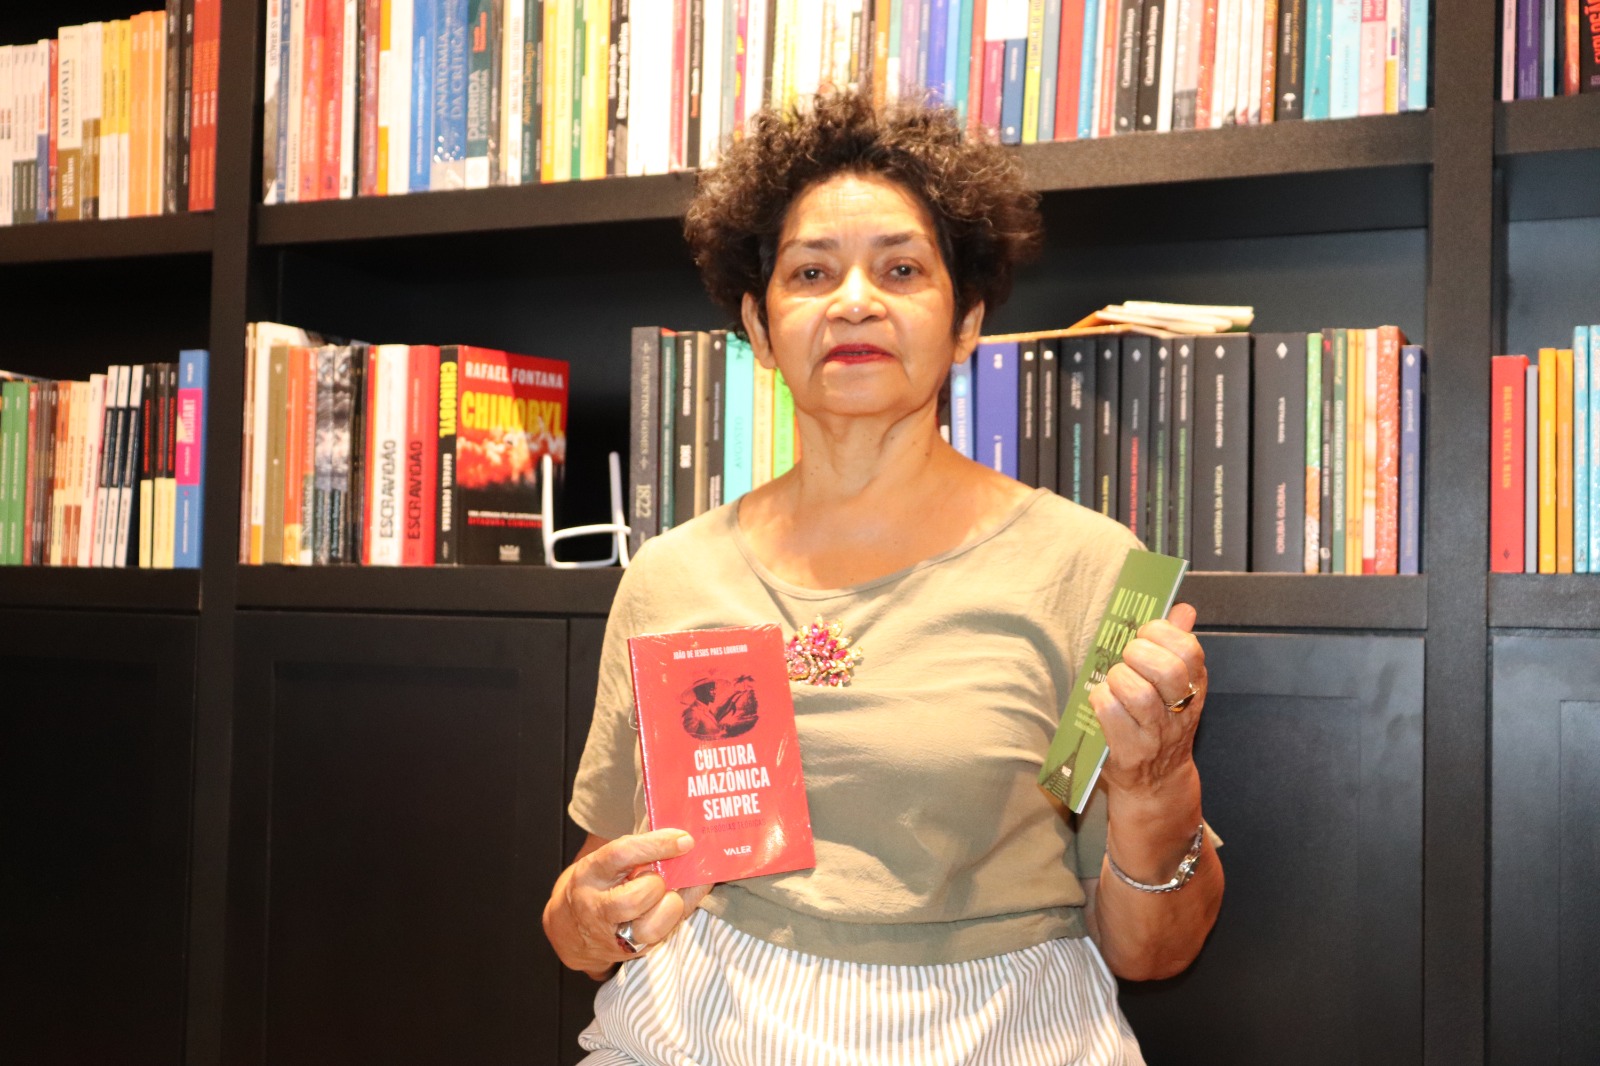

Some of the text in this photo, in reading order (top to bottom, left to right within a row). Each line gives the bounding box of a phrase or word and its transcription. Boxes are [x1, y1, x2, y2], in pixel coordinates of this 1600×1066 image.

[467, 70, 480, 139] DERRIDA
[465, 360, 564, 390] RAFAEL FONTANA
[439, 361, 457, 438] CHINOBYL
[461, 390, 562, 438] CHINOBYL
[640, 356, 651, 455] LAURENTINO GOMES
[1503, 386, 1513, 424] BRASIL
[1333, 400, 1344, 532] MICROFÍSICAS DO IMPERIALISMO
[636, 484, 651, 518] 1822
[1215, 497, 1223, 509] DA
[1277, 482, 1286, 519] GLOBAL
[1214, 548, 1222, 556] A
[694, 743, 757, 771] CULTURA
[687, 766, 771, 798] AMAZÔNICA
[702, 793, 761, 821] SEMPRE
[723, 845, 752, 856] VALER
